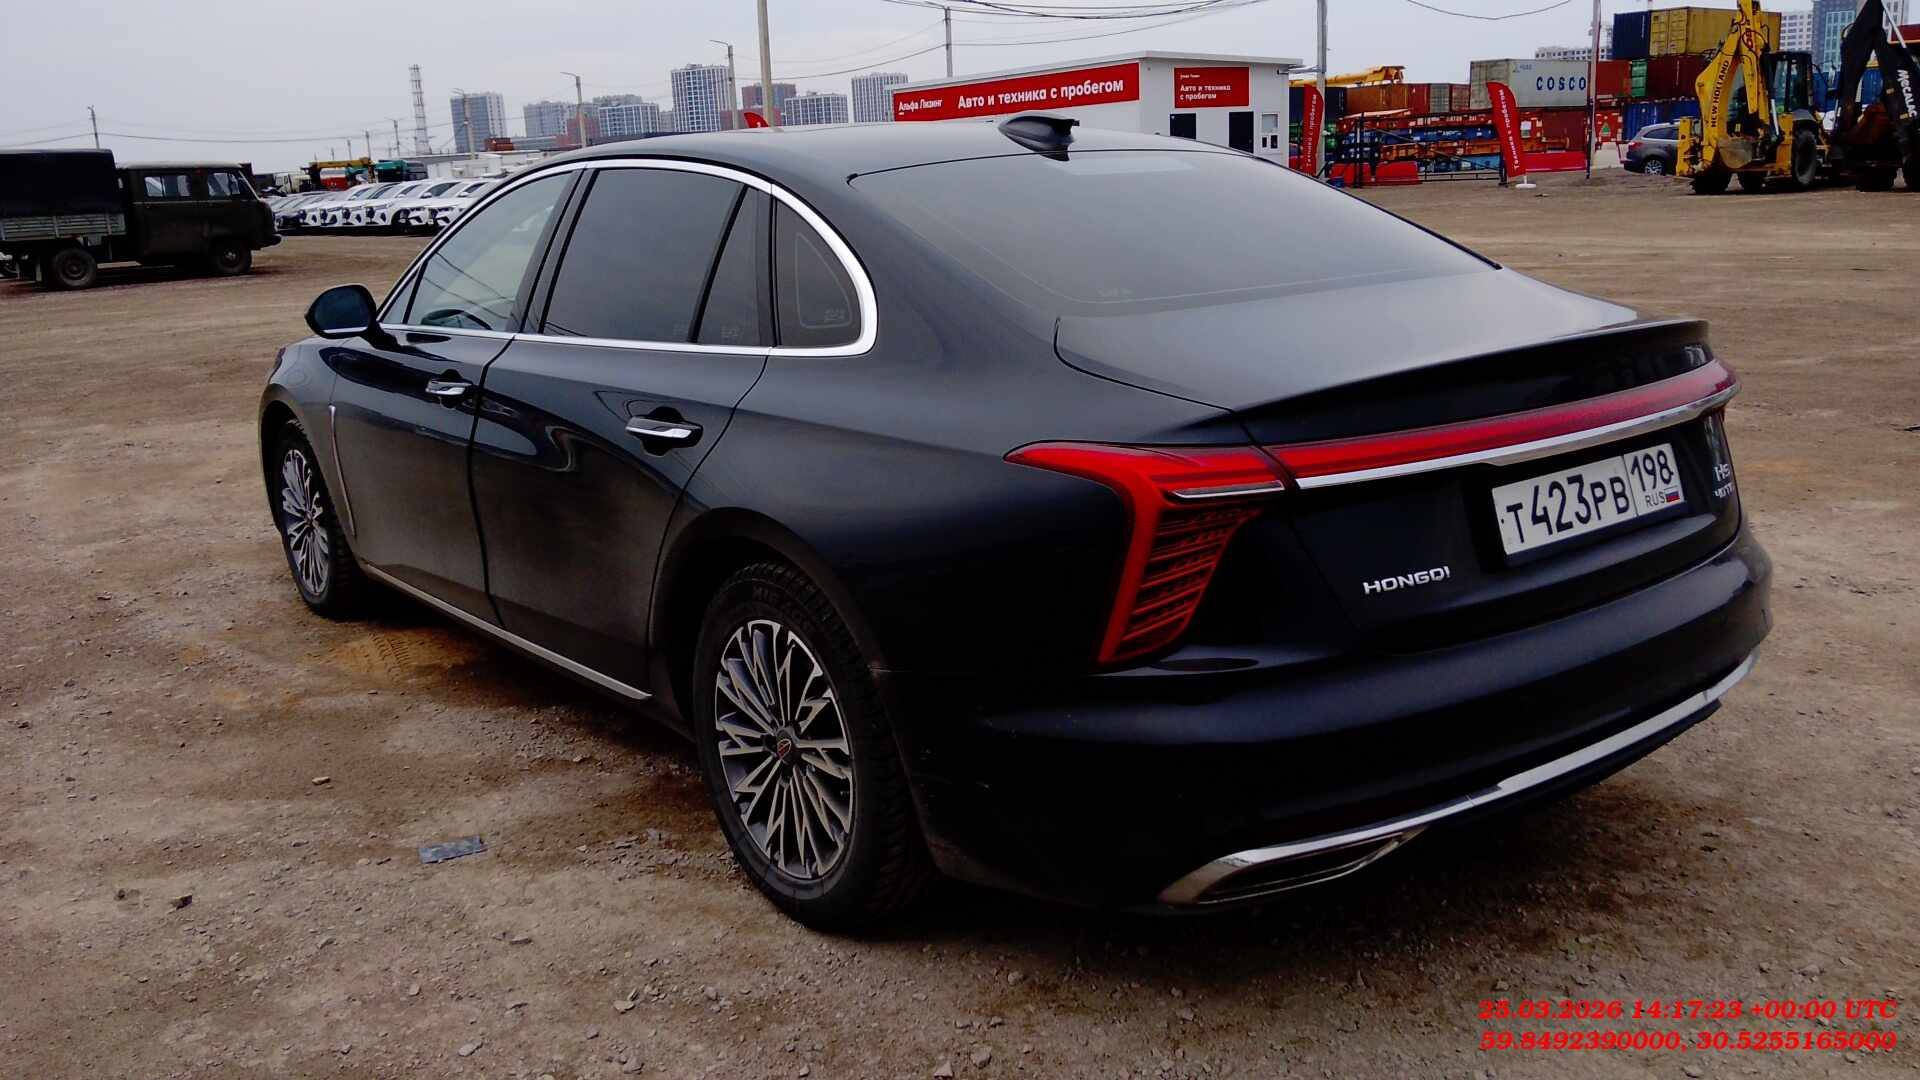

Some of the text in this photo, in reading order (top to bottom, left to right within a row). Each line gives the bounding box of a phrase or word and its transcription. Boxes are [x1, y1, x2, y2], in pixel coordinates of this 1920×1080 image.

[1180, 84, 1197, 92] Авто
[1536, 76, 1586, 91] COSCO
[1713, 60, 1730, 105] HOLLAND
[957, 79, 1124, 109] Авто и техника с пробегом
[1185, 91, 1217, 101] пробегом
[898, 98, 942, 113] Альфа Лизинг
[1630, 450, 1674, 492] 198
[1645, 491, 1666, 507] RUS
[1363, 566, 1451, 594] HONGQI
